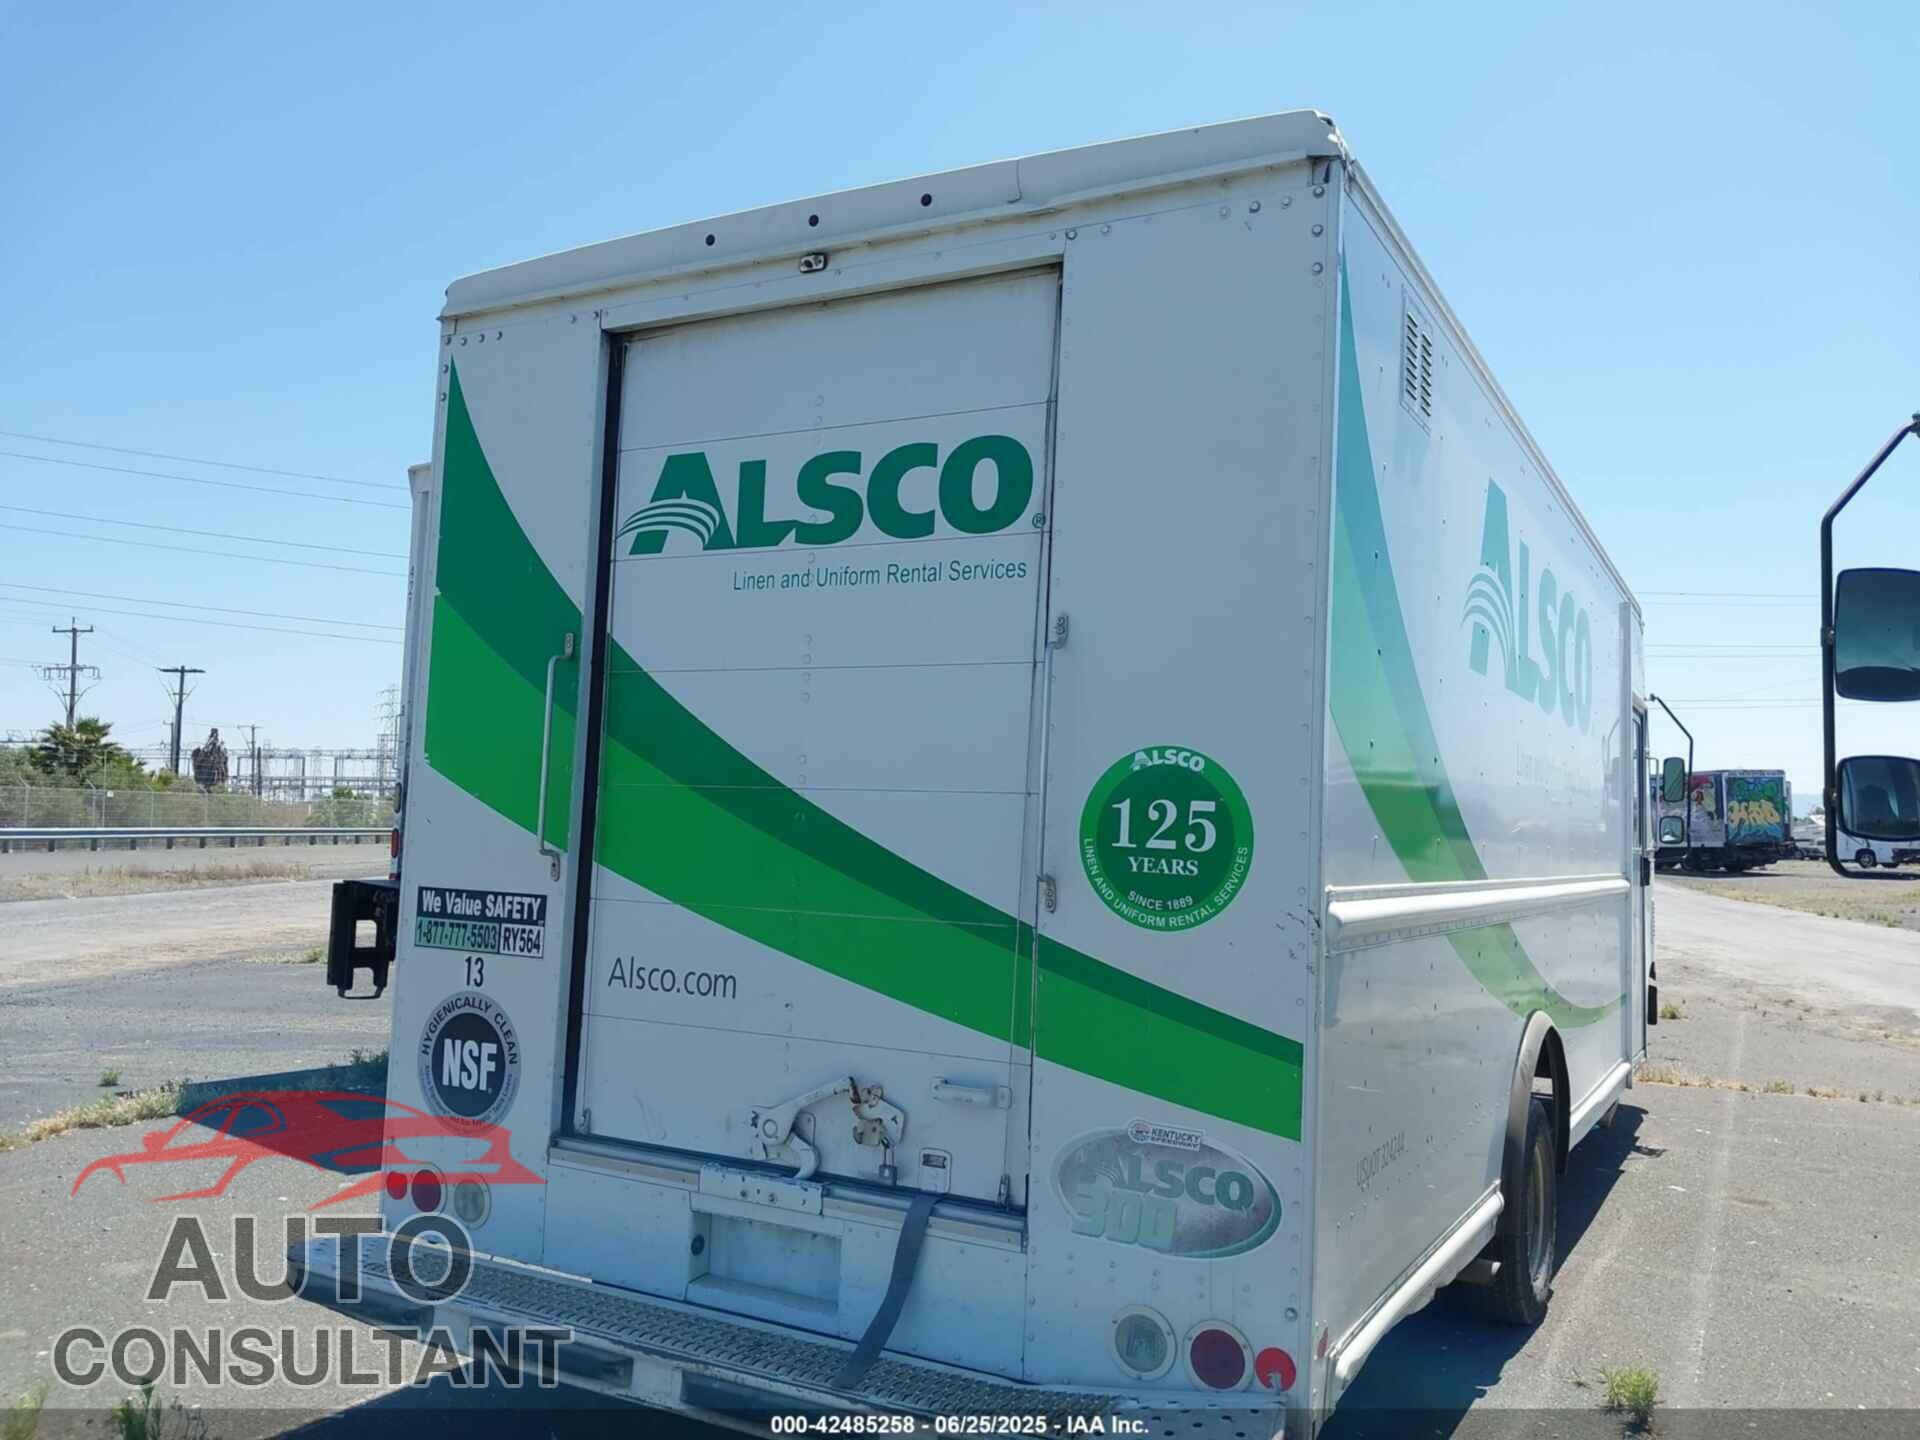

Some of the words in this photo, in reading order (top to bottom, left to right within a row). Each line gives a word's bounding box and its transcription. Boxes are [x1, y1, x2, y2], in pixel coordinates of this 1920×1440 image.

[615, 434, 1034, 556] ALSCO
[733, 571, 775, 591] Linen
[780, 571, 812, 589] and
[816, 565, 882, 588] Uniform
[887, 562, 943, 583] Rental
[948, 558, 1027, 581] Services
[1461, 477, 1592, 737] ALSCO
[1130, 749, 1206, 773] ALSCO
[1111, 798, 1217, 853] 125
[1084, 837, 1098, 875] LINEN
[1094, 876, 1115, 900] AND
[1113, 898, 1166, 927] UNIFORM
[1169, 904, 1216, 927] RENTAL
[1214, 846, 1248, 906] SERVICES
[1128, 856, 1199, 876] YEARS
[422, 889, 441, 913] We
[446, 891, 482, 917] Value
[485, 894, 541, 920] SAFETY
[1127, 890, 1163, 911] SINCE
[1167, 895, 1194, 911] 1889
[502, 926, 541, 954] RY564
[465, 956, 484, 987] 13
[608, 957, 737, 999] Alsco.com
[421, 996, 493, 1056] HYGIENICALLY
[494, 1012, 519, 1066] CLEAN
[442, 1038, 498, 1091] NSF
[1151, 1127, 1201, 1144] KENTUCKY
[1076, 1149, 1254, 1211] ALSCO
